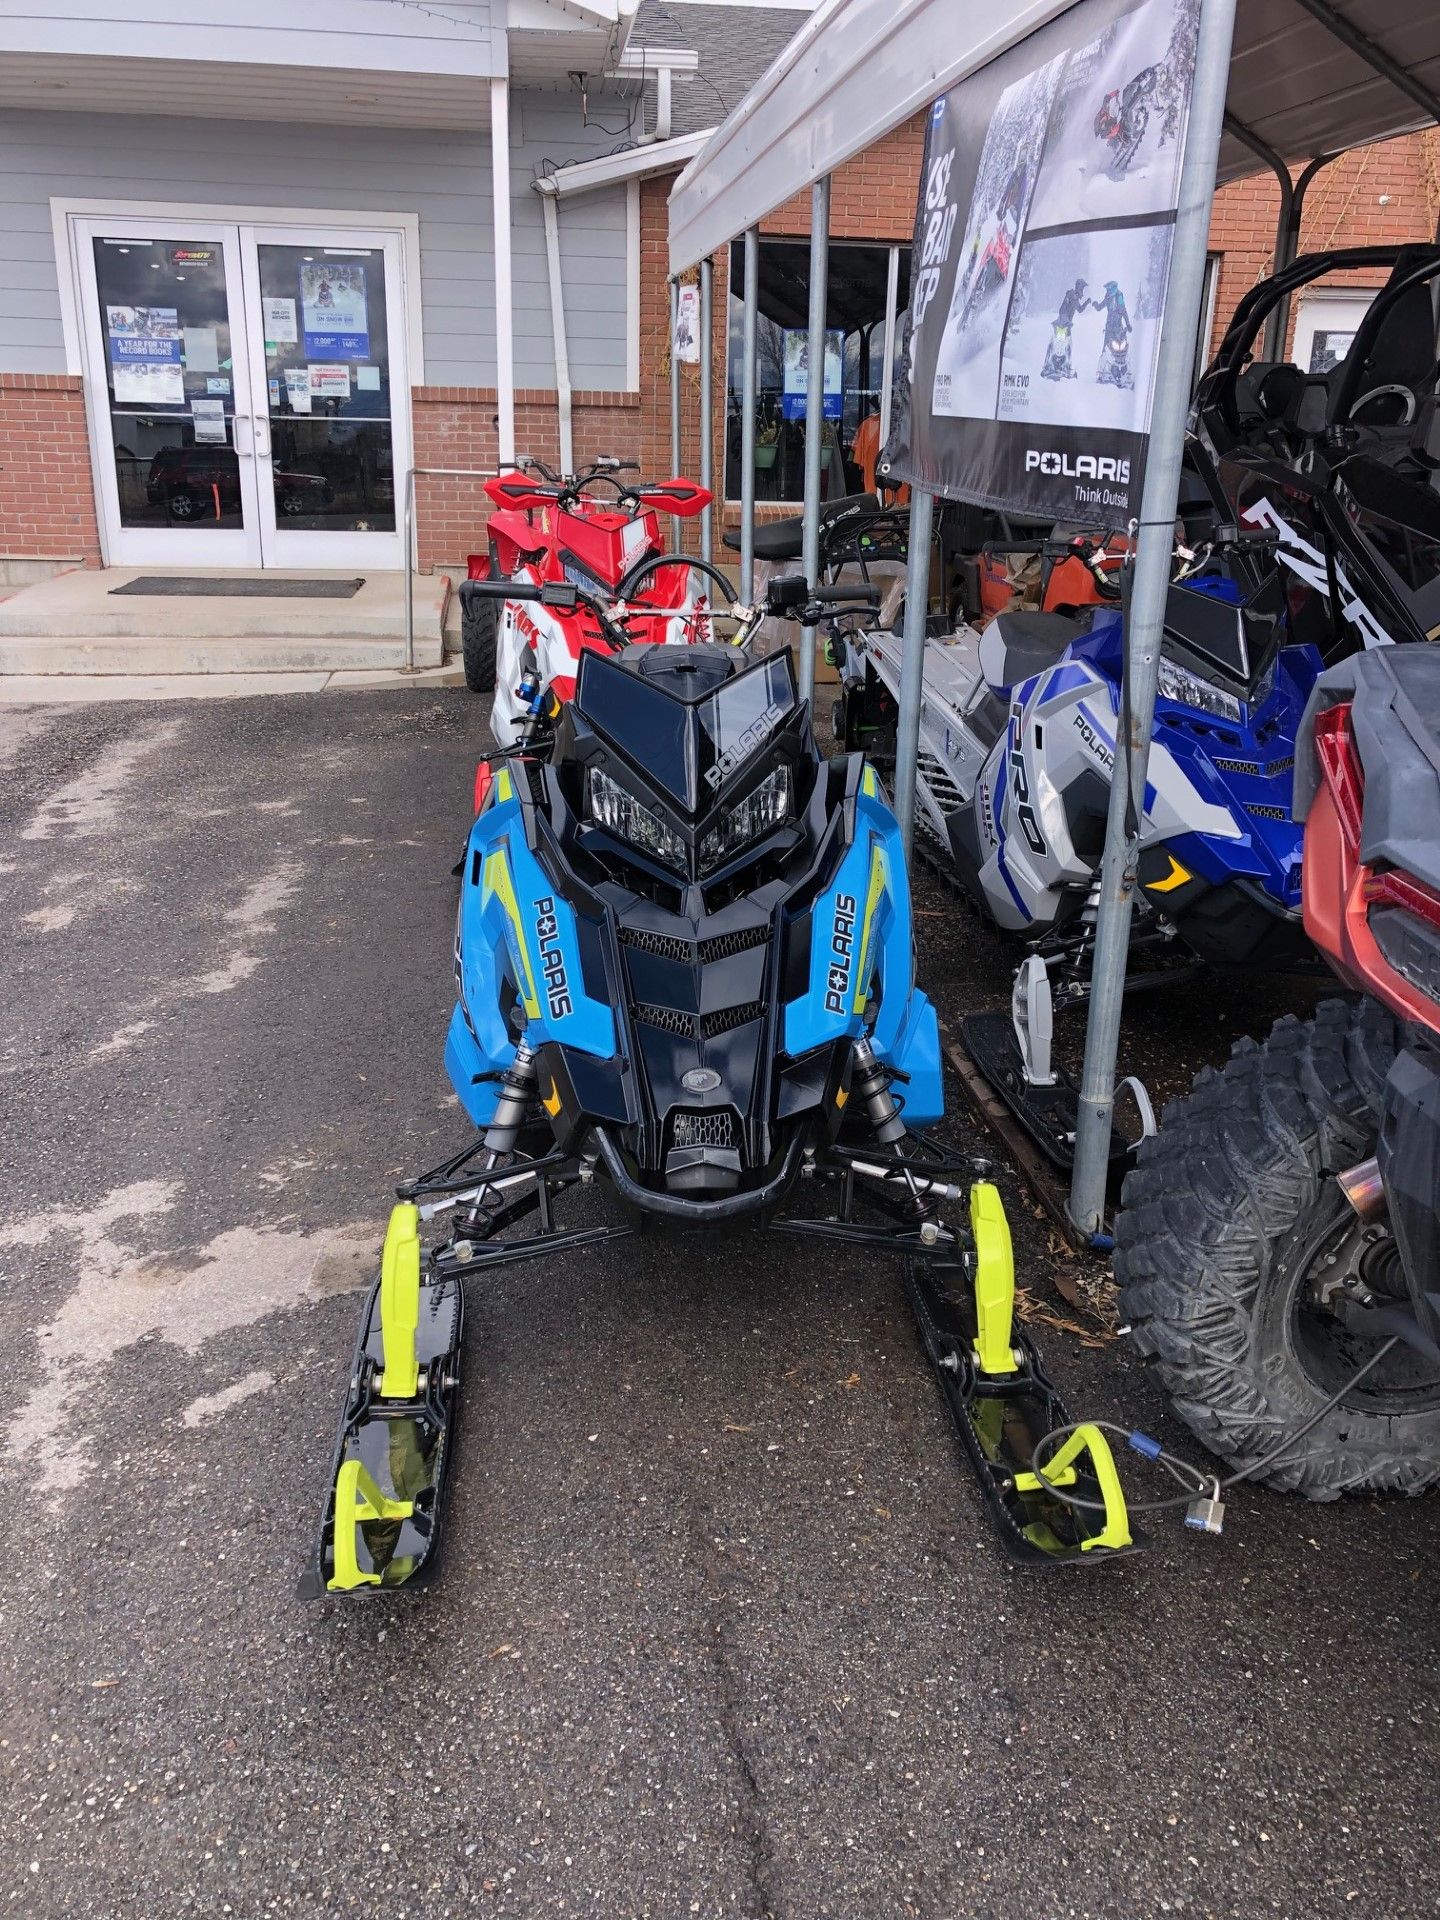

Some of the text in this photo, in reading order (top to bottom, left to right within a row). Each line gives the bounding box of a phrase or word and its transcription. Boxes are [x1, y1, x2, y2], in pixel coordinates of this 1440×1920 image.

[119, 346, 172, 356] RECORD BOOKS
[124, 340, 143, 348] YEAR
[144, 340, 158, 348] FOR
[159, 341, 173, 349] THE
[1003, 375, 1030, 388] RMK EVO
[1025, 450, 1131, 484] POLARIS
[1075, 485, 1129, 509] Think Outside
[617, 535, 654, 570] POLARIS
[703, 702, 785, 789] POLARIS
[1072, 714, 1116, 772] POLAR
[1010, 702, 1048, 858] PRO
[532, 895, 574, 1022] POLARIS
[824, 891, 857, 1018] POLARIS
